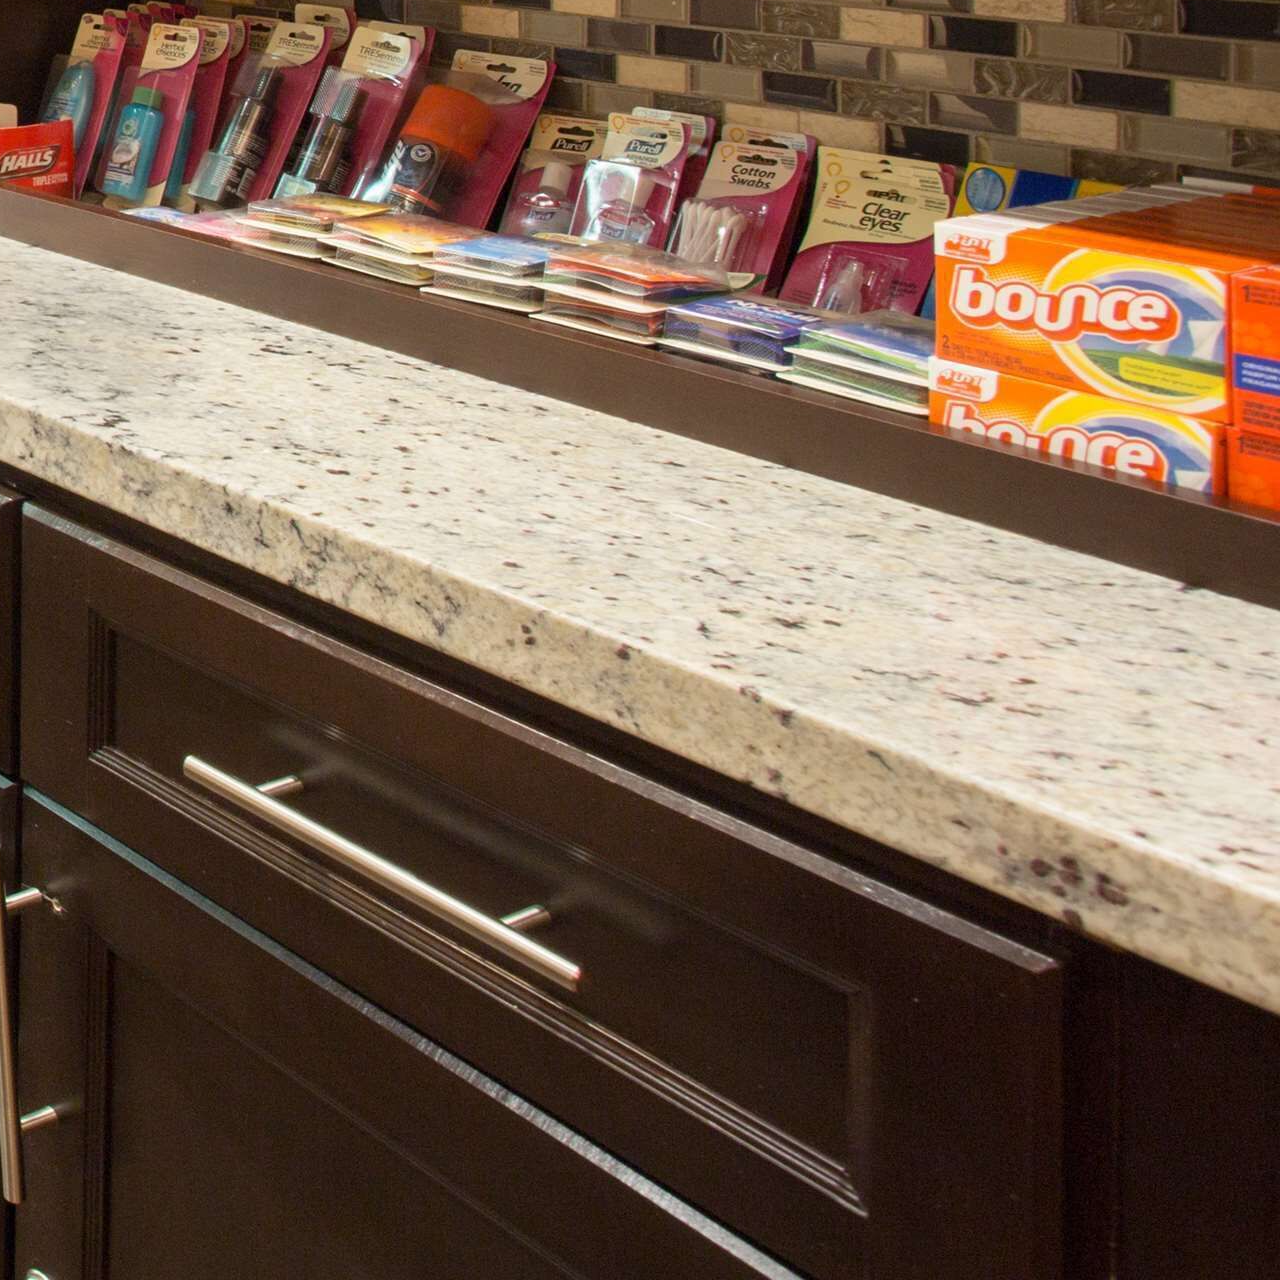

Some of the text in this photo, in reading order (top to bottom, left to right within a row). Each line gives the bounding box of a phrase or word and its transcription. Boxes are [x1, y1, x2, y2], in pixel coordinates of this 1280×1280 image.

[161, 41, 187, 52] Herbal
[555, 137, 590, 152] Purell
[629, 140, 664, 155] Purell
[0, 150, 55, 174] HALLS
[731, 163, 777, 180] Cotton
[729, 174, 772, 190] Swabs
[862, 201, 911, 222] Clear
[954, 268, 1169, 332] bounce
